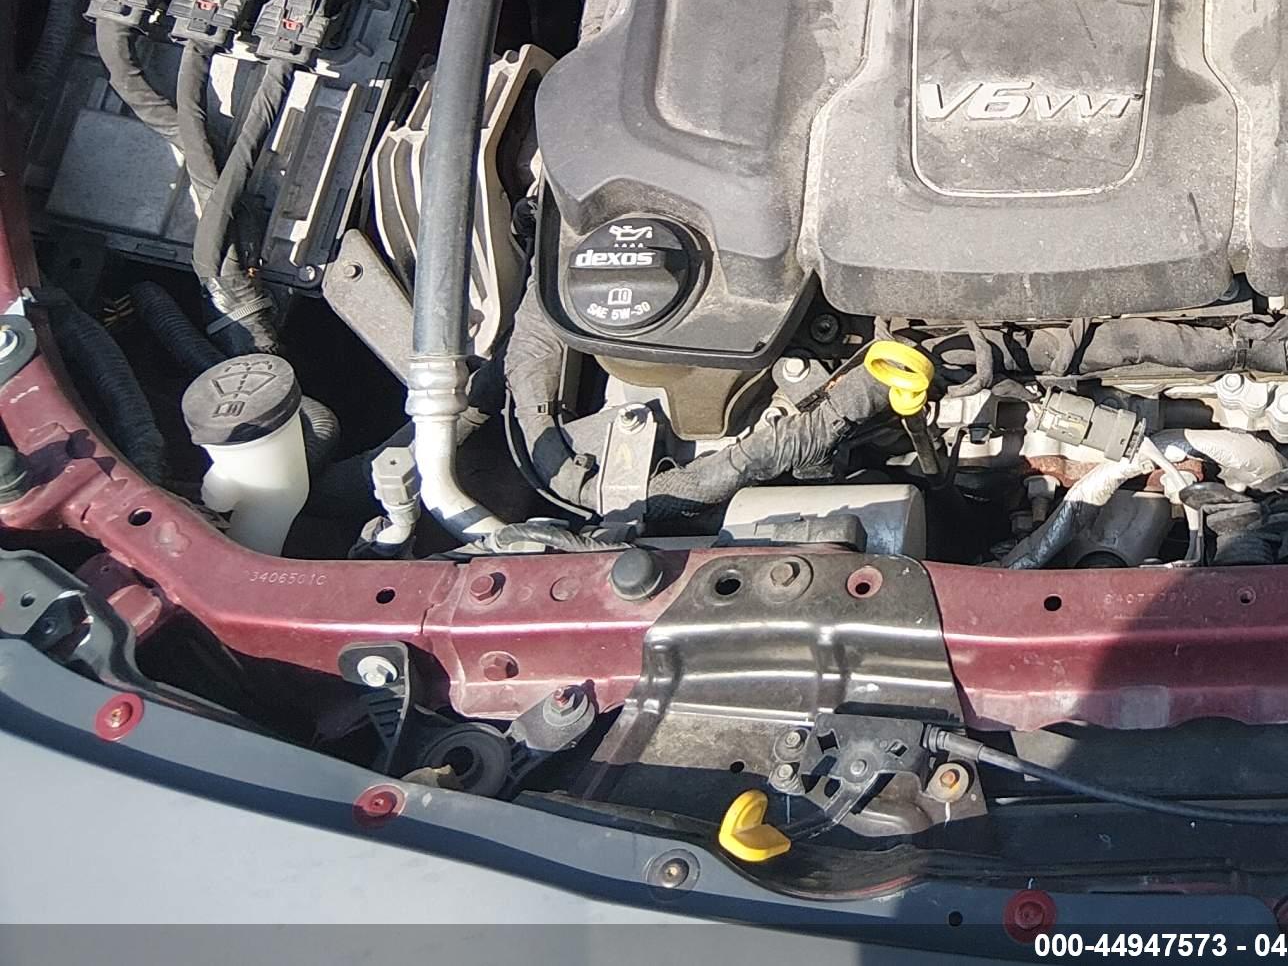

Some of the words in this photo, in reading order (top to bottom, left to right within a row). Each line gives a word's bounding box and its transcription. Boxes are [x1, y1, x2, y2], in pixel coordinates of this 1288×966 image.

[575, 249, 656, 267] dexos
[586, 303, 609, 319] SAE
[611, 301, 651, 320] 5W-30
